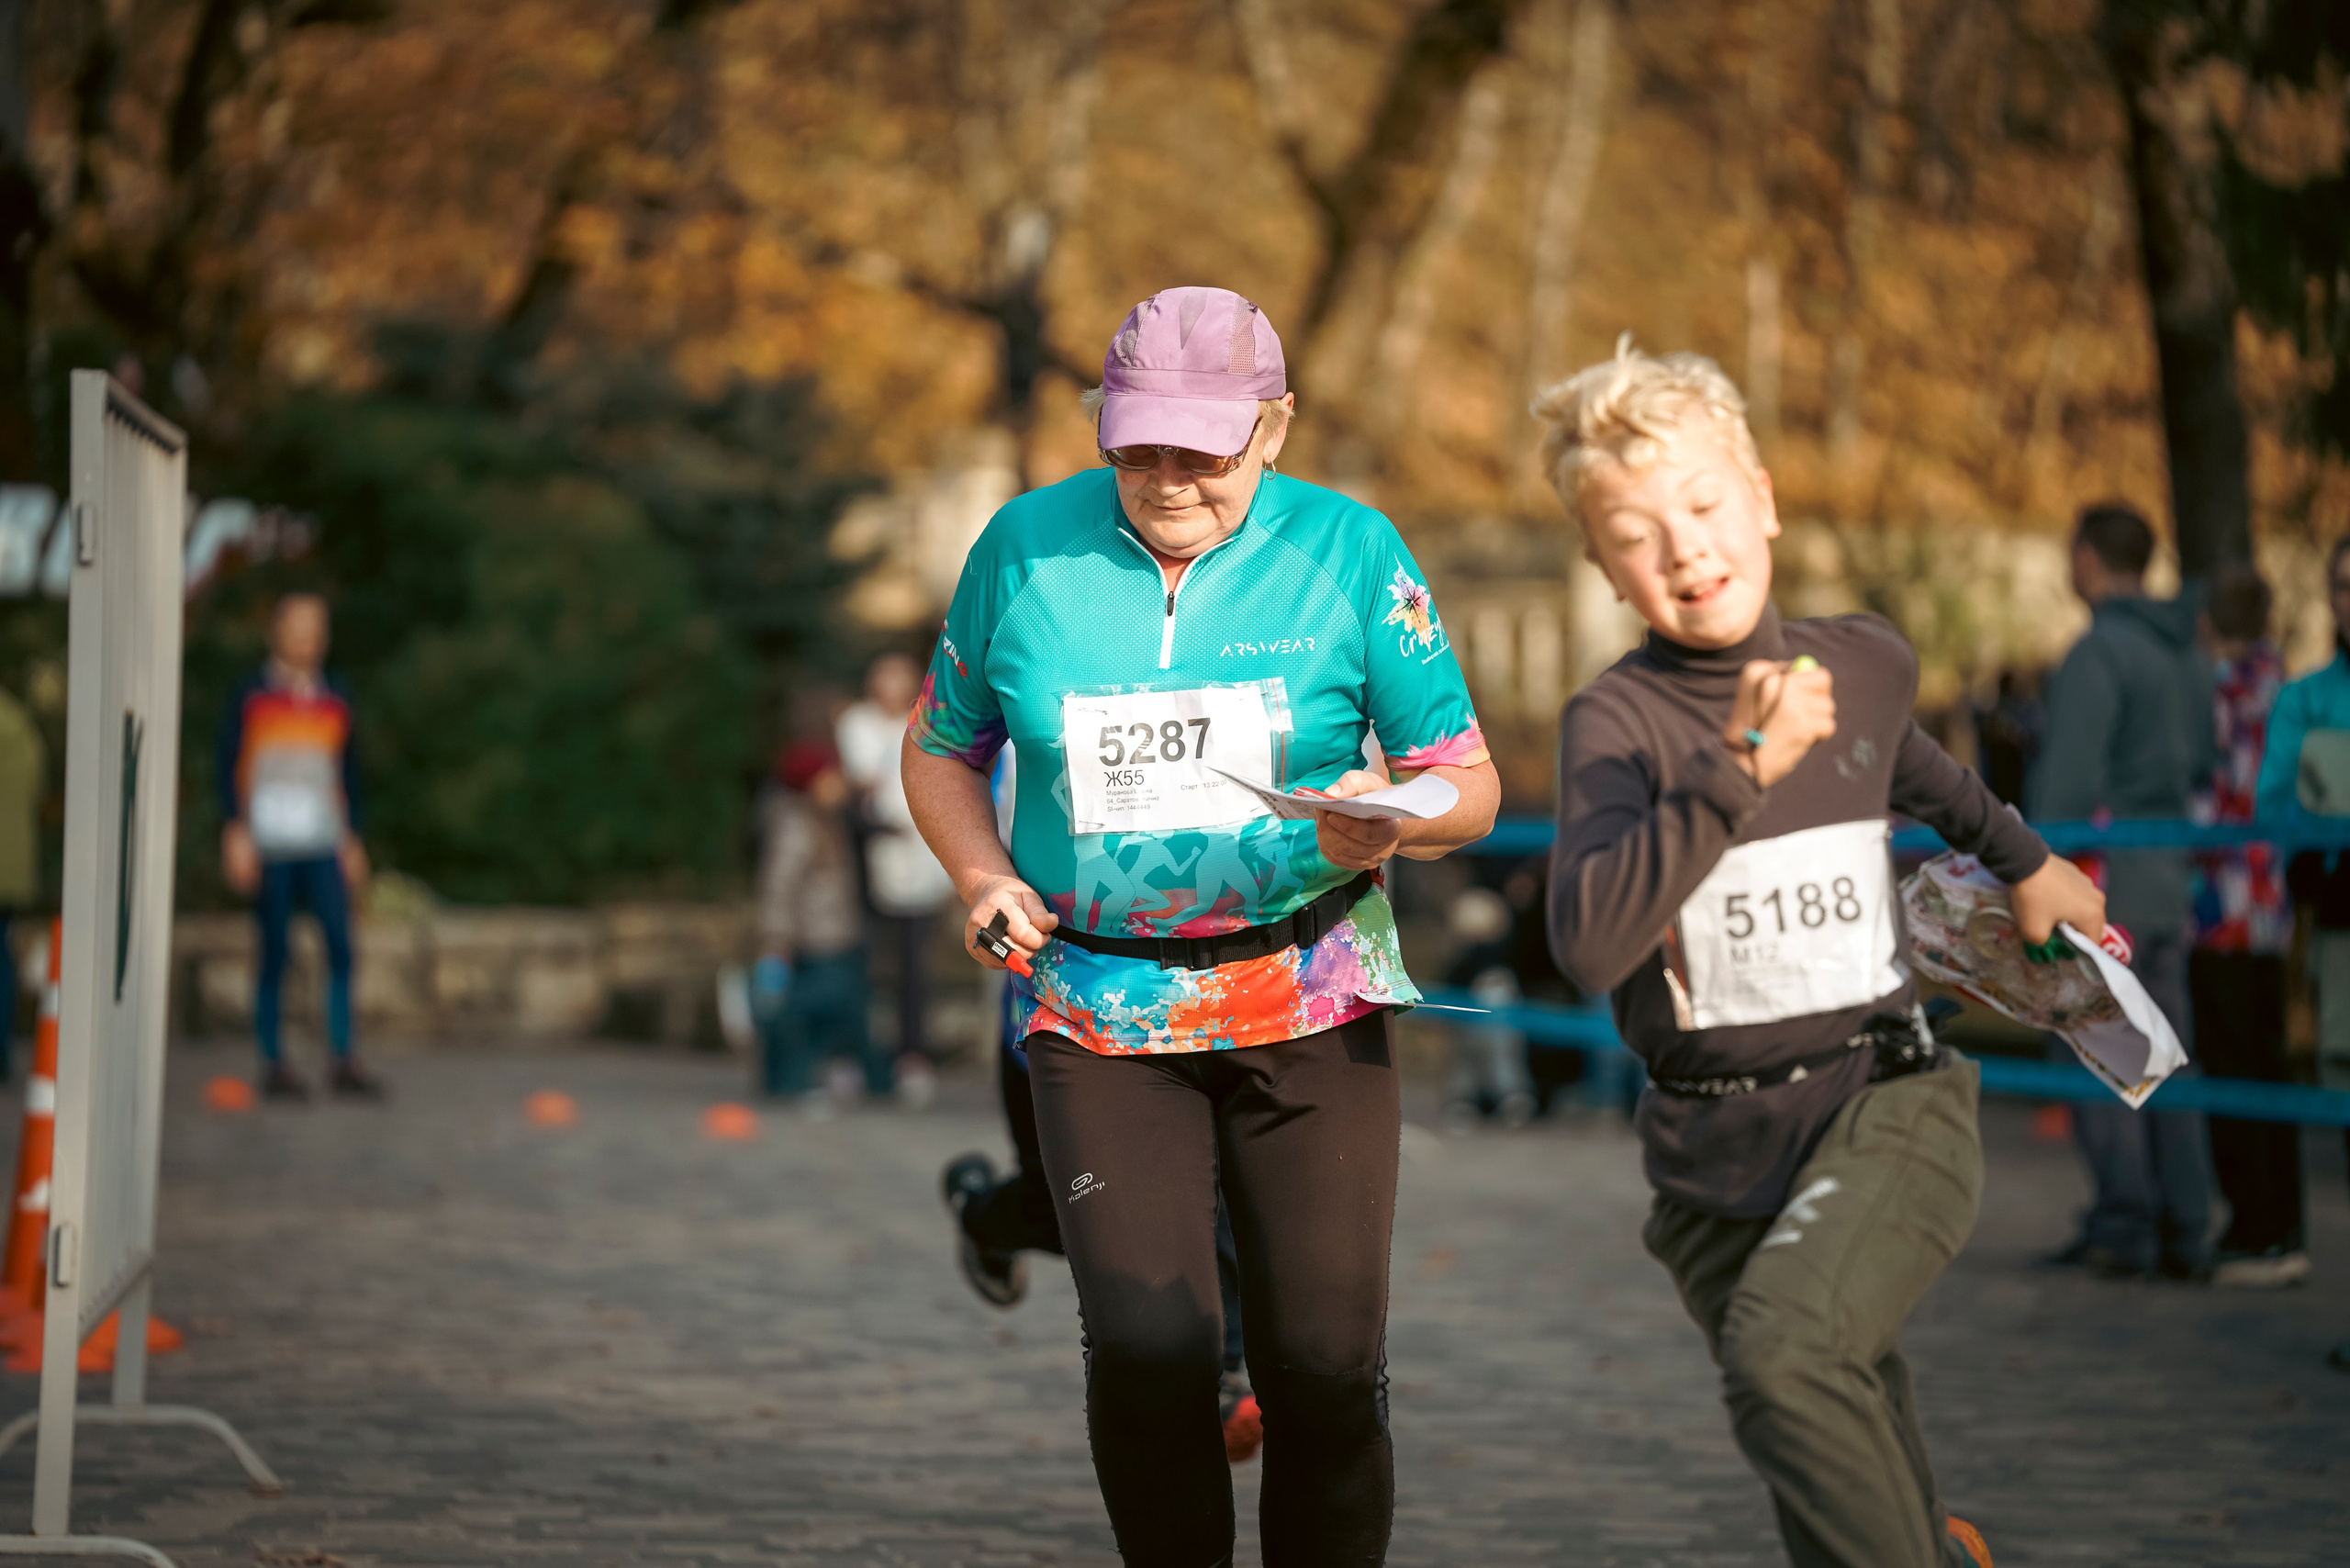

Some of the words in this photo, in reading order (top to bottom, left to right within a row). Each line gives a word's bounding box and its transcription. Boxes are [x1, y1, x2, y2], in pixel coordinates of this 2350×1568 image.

[1220, 637, 1315, 656] ARSWEAR
[1098, 717, 1212, 767] 5287
[1103, 769, 1146, 788] Ж55
[1180, 783, 1199, 791] Старт
[1724, 876, 1862, 939] 5188
